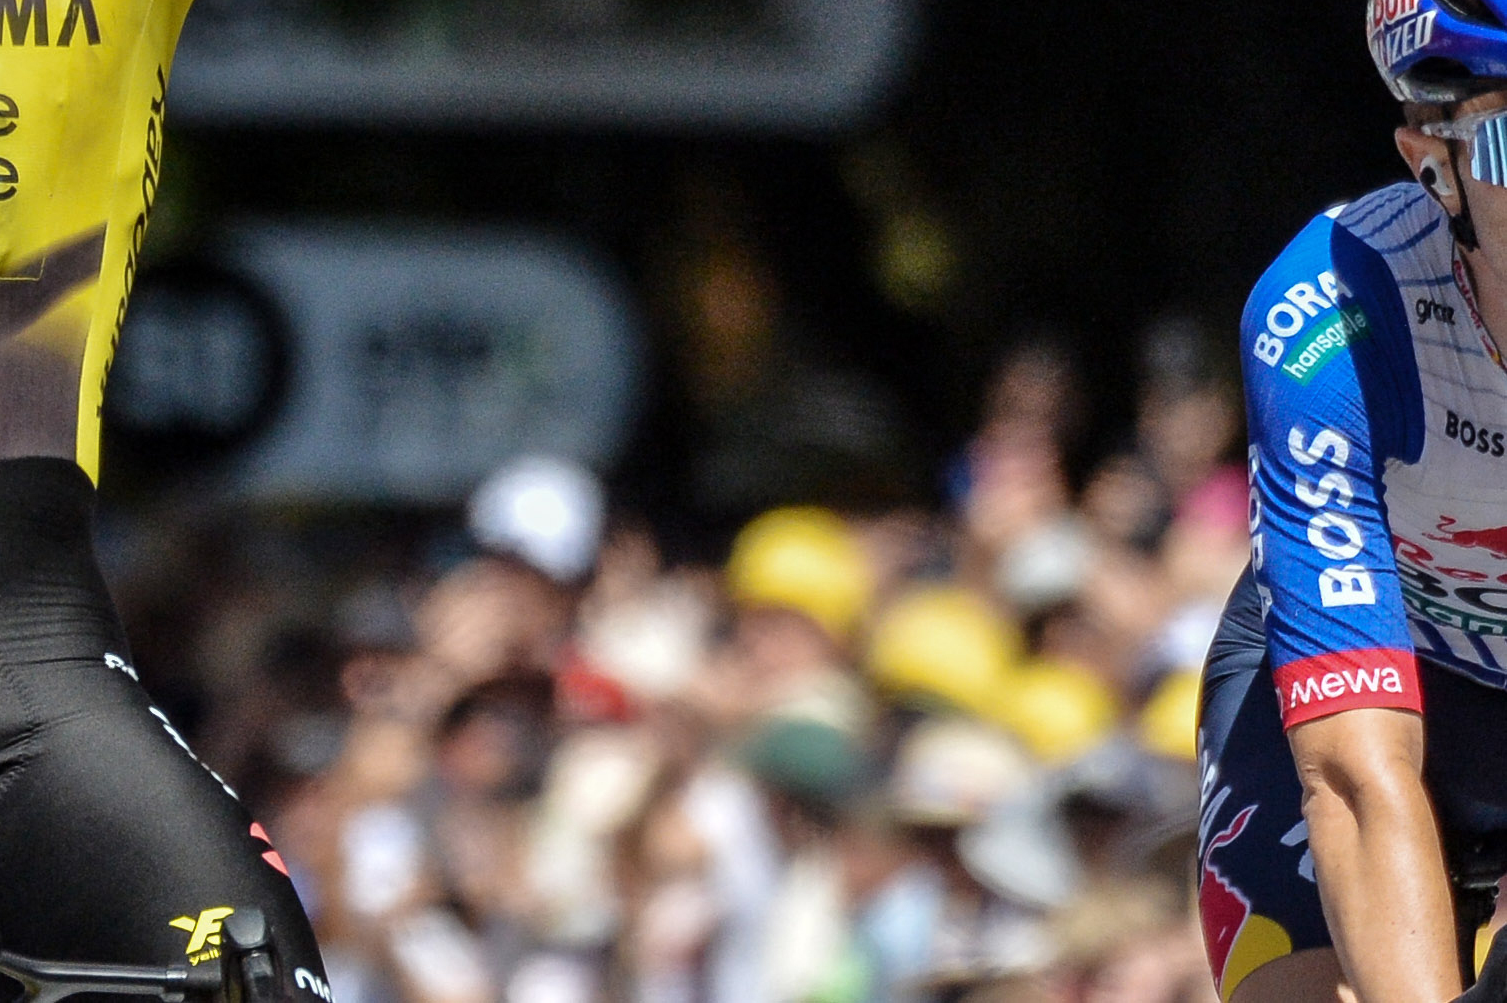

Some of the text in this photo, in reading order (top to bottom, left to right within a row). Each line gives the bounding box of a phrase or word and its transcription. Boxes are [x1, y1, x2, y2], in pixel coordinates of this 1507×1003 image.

[1254, 271, 1354, 368] BORA
[1445, 410, 1505, 458] BOSS
[1288, 426, 1376, 608] BOSS
[1392, 533, 1507, 583] Re
